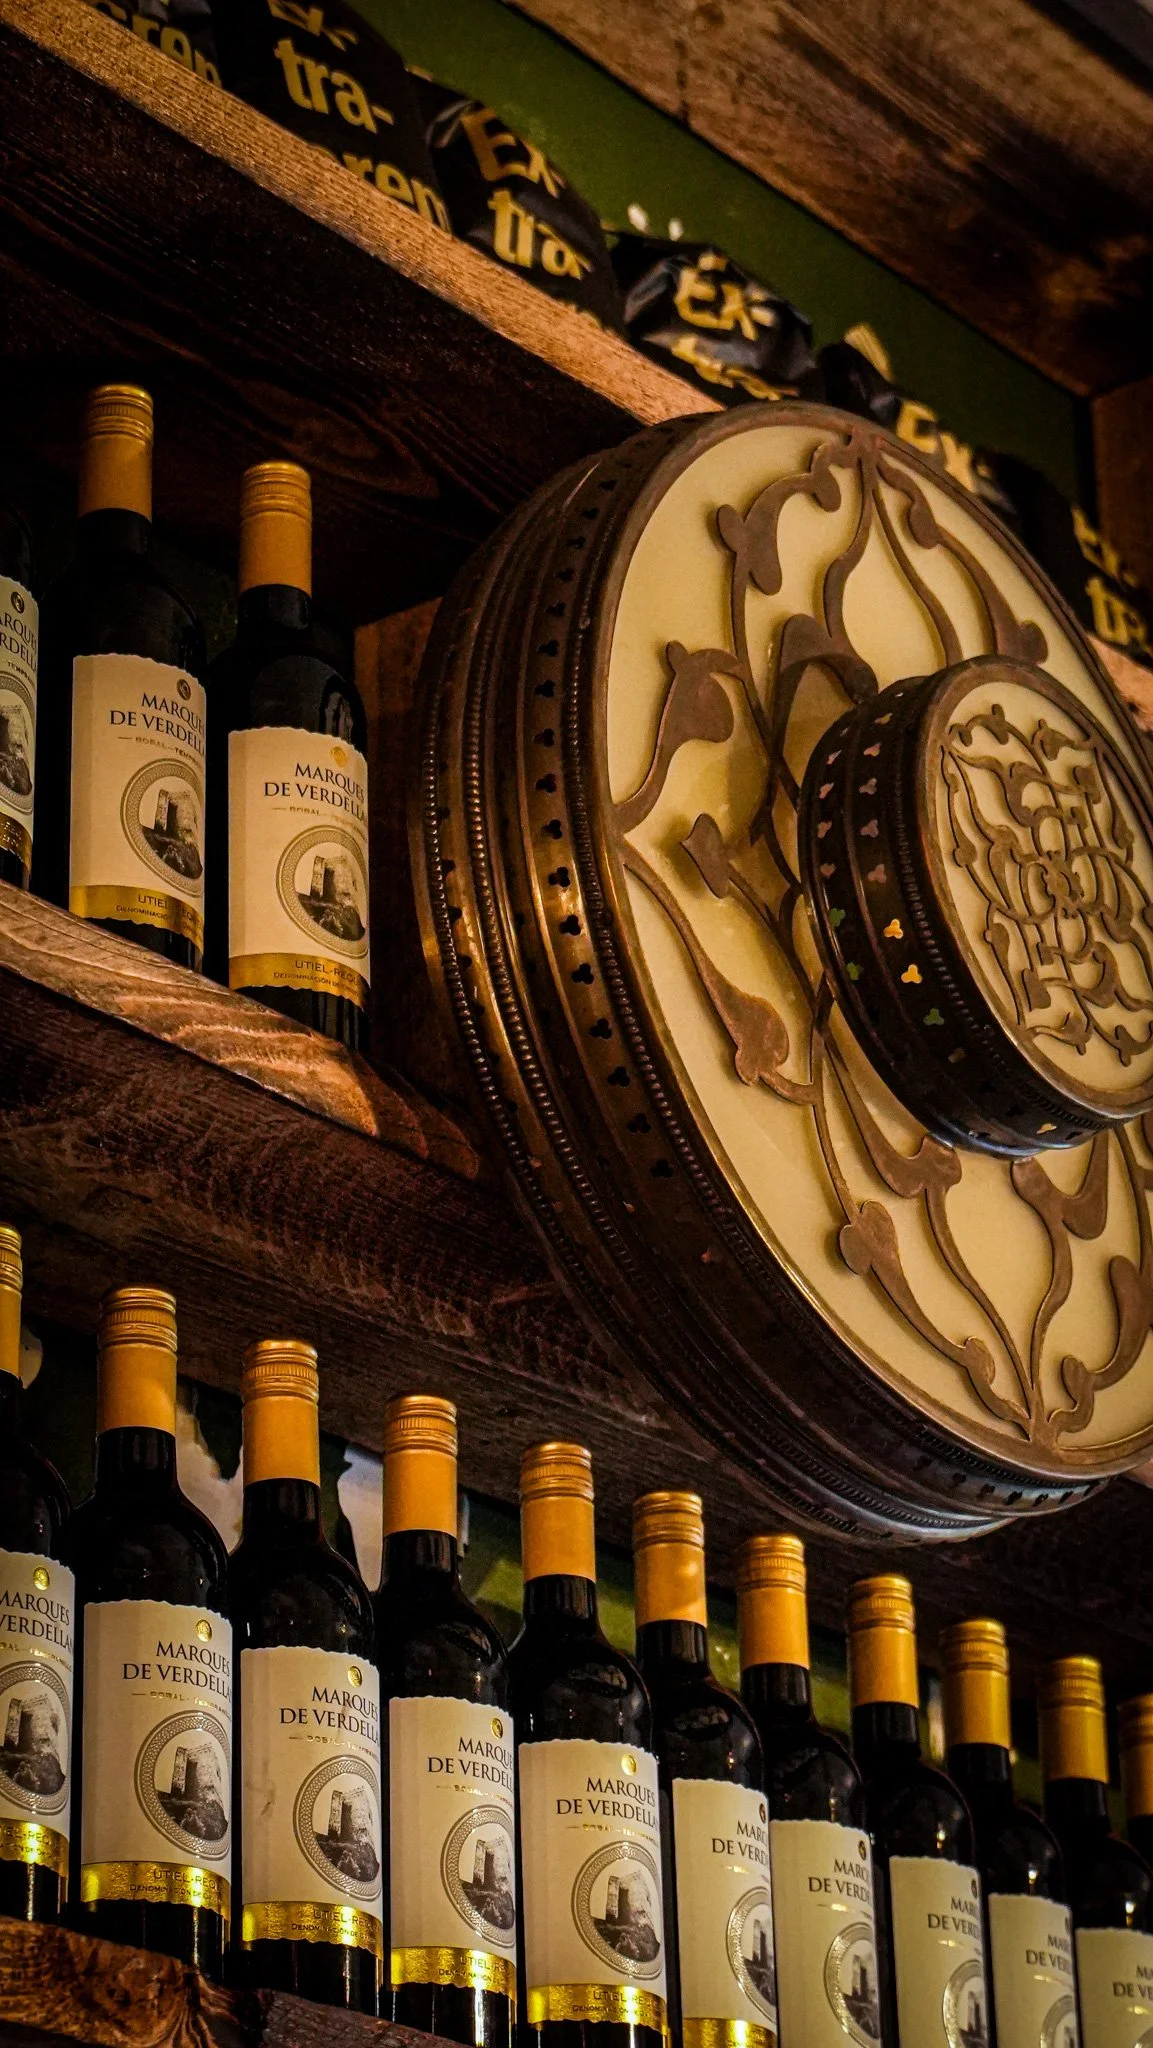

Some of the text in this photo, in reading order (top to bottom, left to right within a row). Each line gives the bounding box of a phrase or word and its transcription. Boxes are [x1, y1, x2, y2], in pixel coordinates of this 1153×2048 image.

[273, 39, 395, 134] tra-
[109, 710, 137, 727] DE
[263, 781, 291, 797] DE
[294, 762, 365, 805] MARQUES
[156, 1640, 231, 1678] MARQUES
[122, 1663, 151, 1680] DE
[280, 1708, 308, 1725] DE
[427, 1756, 455, 1774] DE
[586, 1777, 656, 1808] MARQUES
[556, 1799, 583, 1815] DE
[711, 1838, 734, 1855] DE
[808, 1876, 831, 1894] DE
[928, 1913, 949, 1930] DE
[1025, 1949, 1047, 1967] DE
[1112, 1981, 1134, 1998] DE
